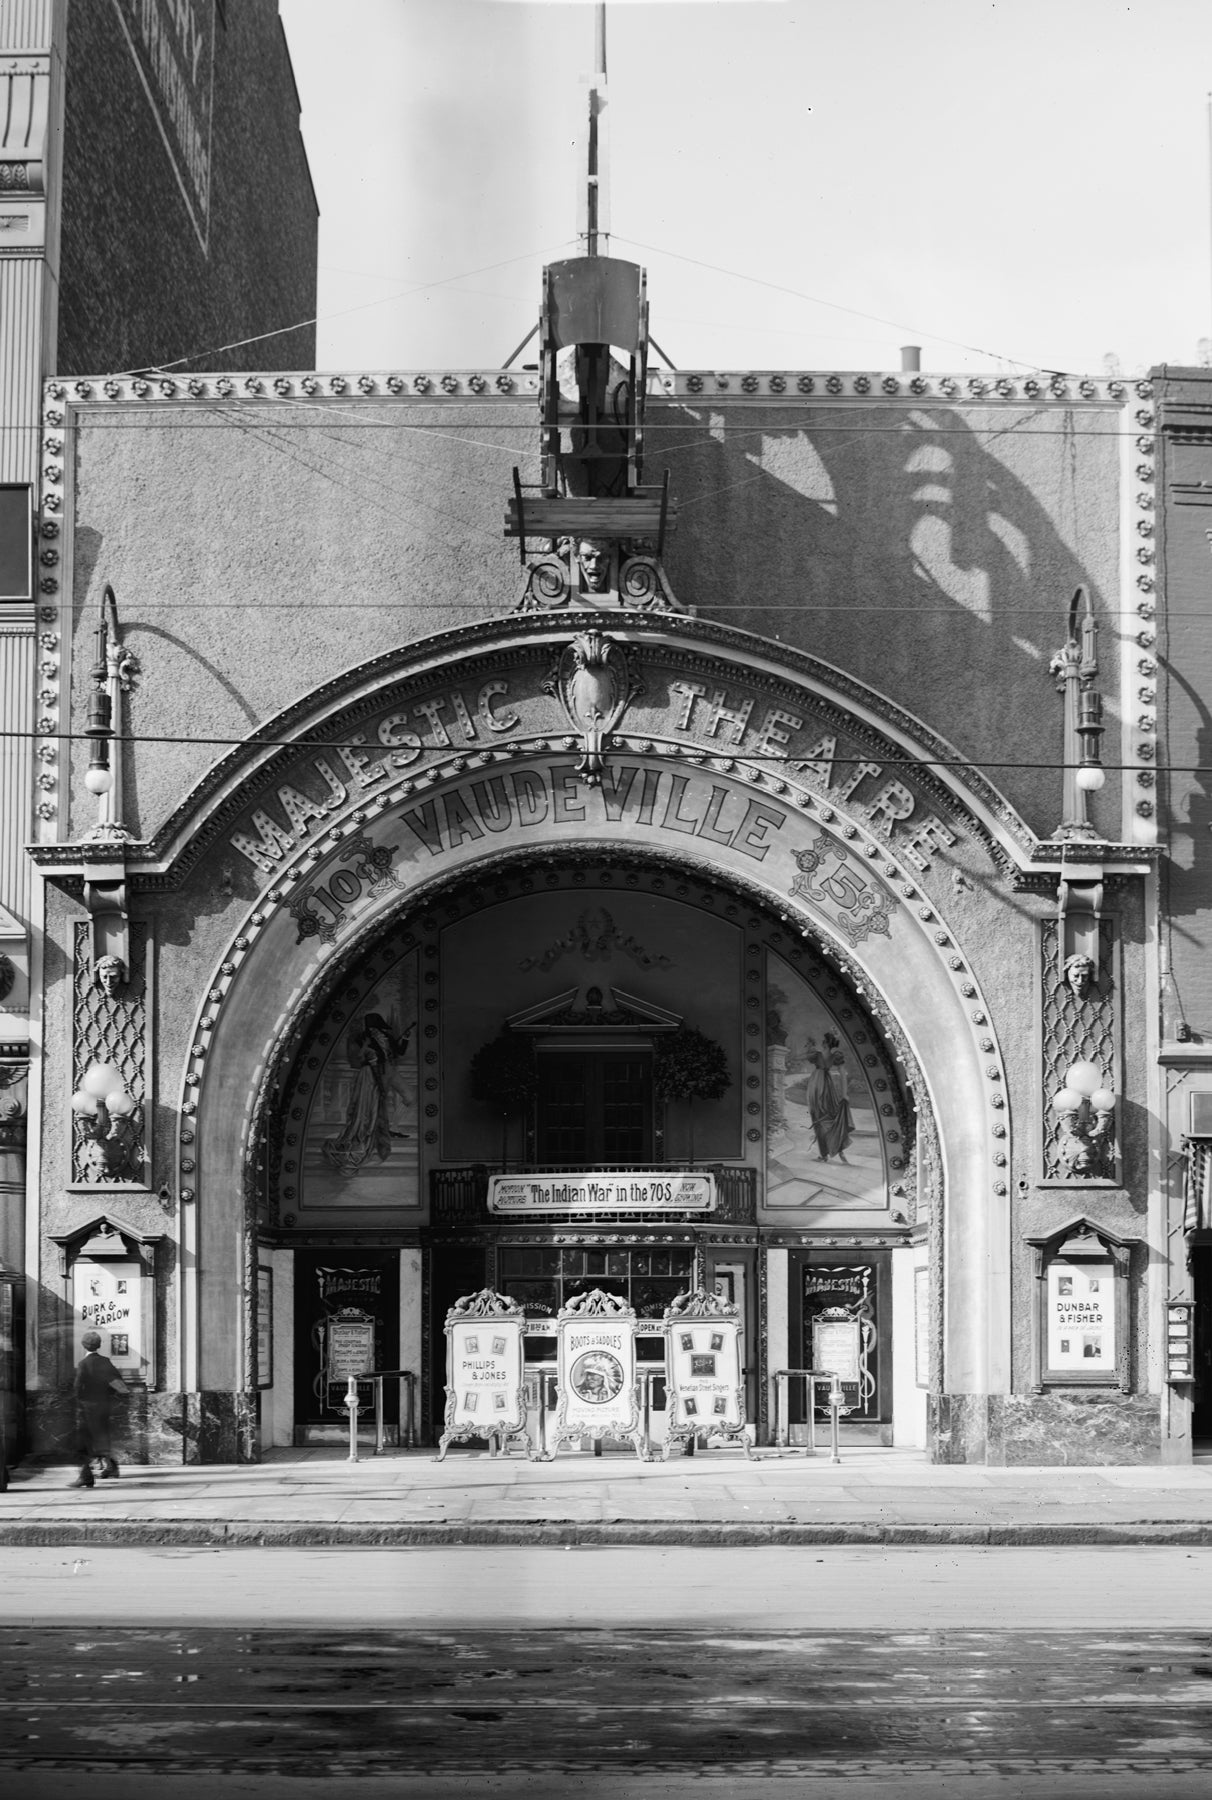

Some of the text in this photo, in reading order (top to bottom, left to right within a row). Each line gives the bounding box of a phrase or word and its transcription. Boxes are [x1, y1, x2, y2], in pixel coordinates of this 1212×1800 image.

[229, 680, 957, 873] MAJESTIC THEATRE
[399, 765, 787, 862] VAUDEVILLE
[552, 1183, 586, 1203] Indian
[616, 1185, 628, 1202] in
[630, 1183, 648, 1202] the
[325, 1274, 381, 1296] MAJESTIC
[805, 1274, 861, 1296] MAJESTIC
[82, 1300, 116, 1321] BURK &
[1056, 1302, 1100, 1312] DUNBAR
[95, 1308, 130, 1326] FARLOW
[1059, 1314, 1104, 1323] & FISHER
[640, 1324, 655, 1332] OPEN
[570, 1335, 590, 1351] BOOTS
[596, 1335, 622, 1350] SADDLES
[462, 1360, 495, 1370] PHILLIPS
[471, 1371, 507, 1380] & JONES
